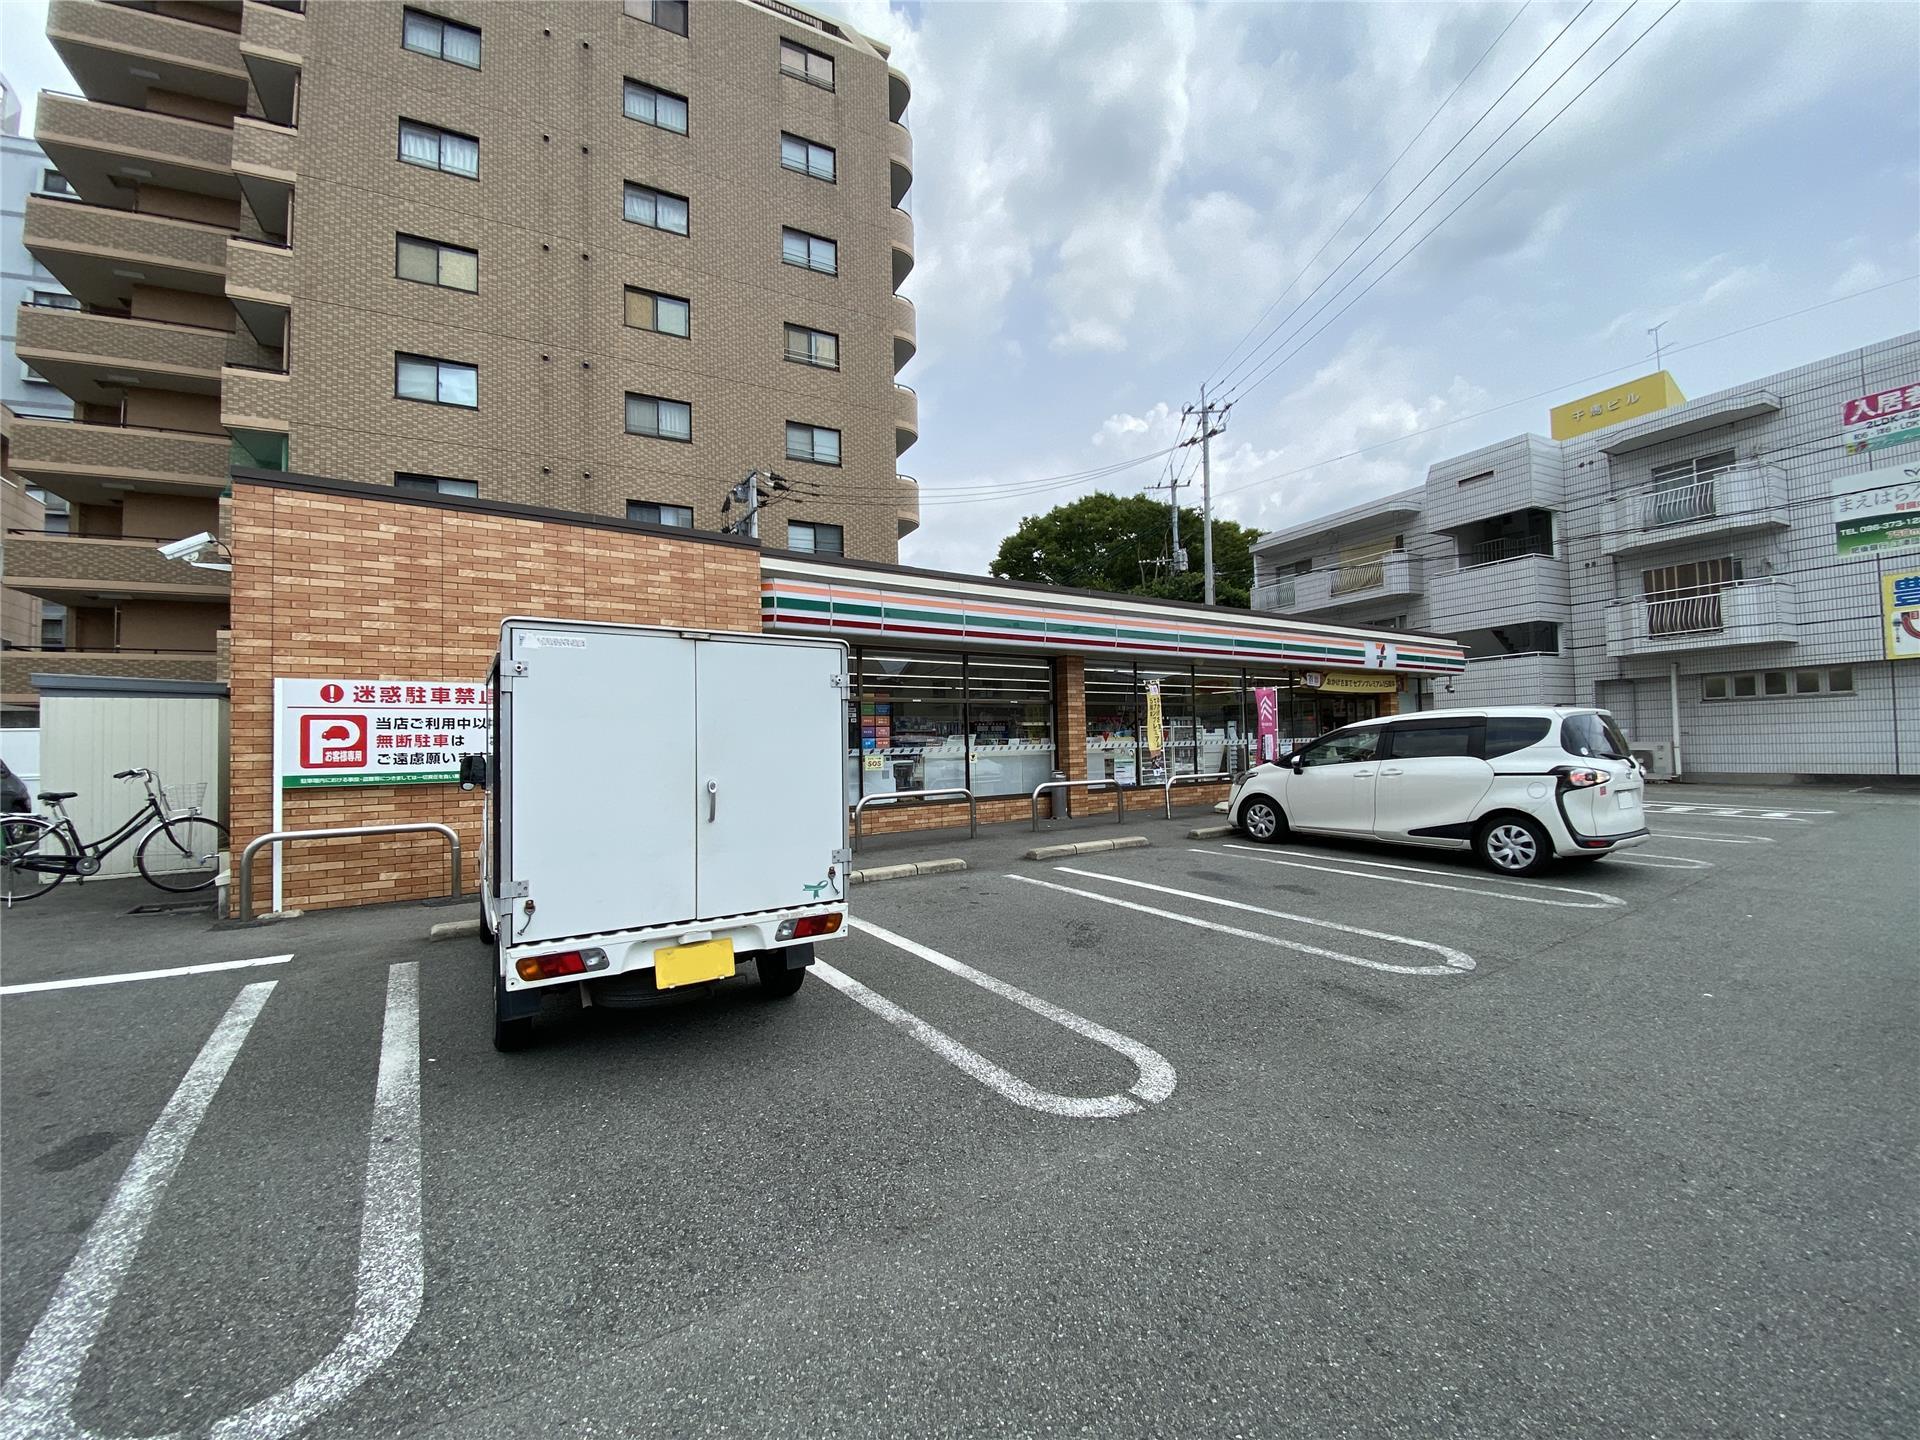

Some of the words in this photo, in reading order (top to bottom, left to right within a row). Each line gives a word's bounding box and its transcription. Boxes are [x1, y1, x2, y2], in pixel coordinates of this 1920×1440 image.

[1840, 528, 1858, 536] TEL
[376, 734, 465, 749] 無断駐車は
[324, 750, 362, 762] お客様専用
[377, 752, 487, 766] ご遠慮願い
